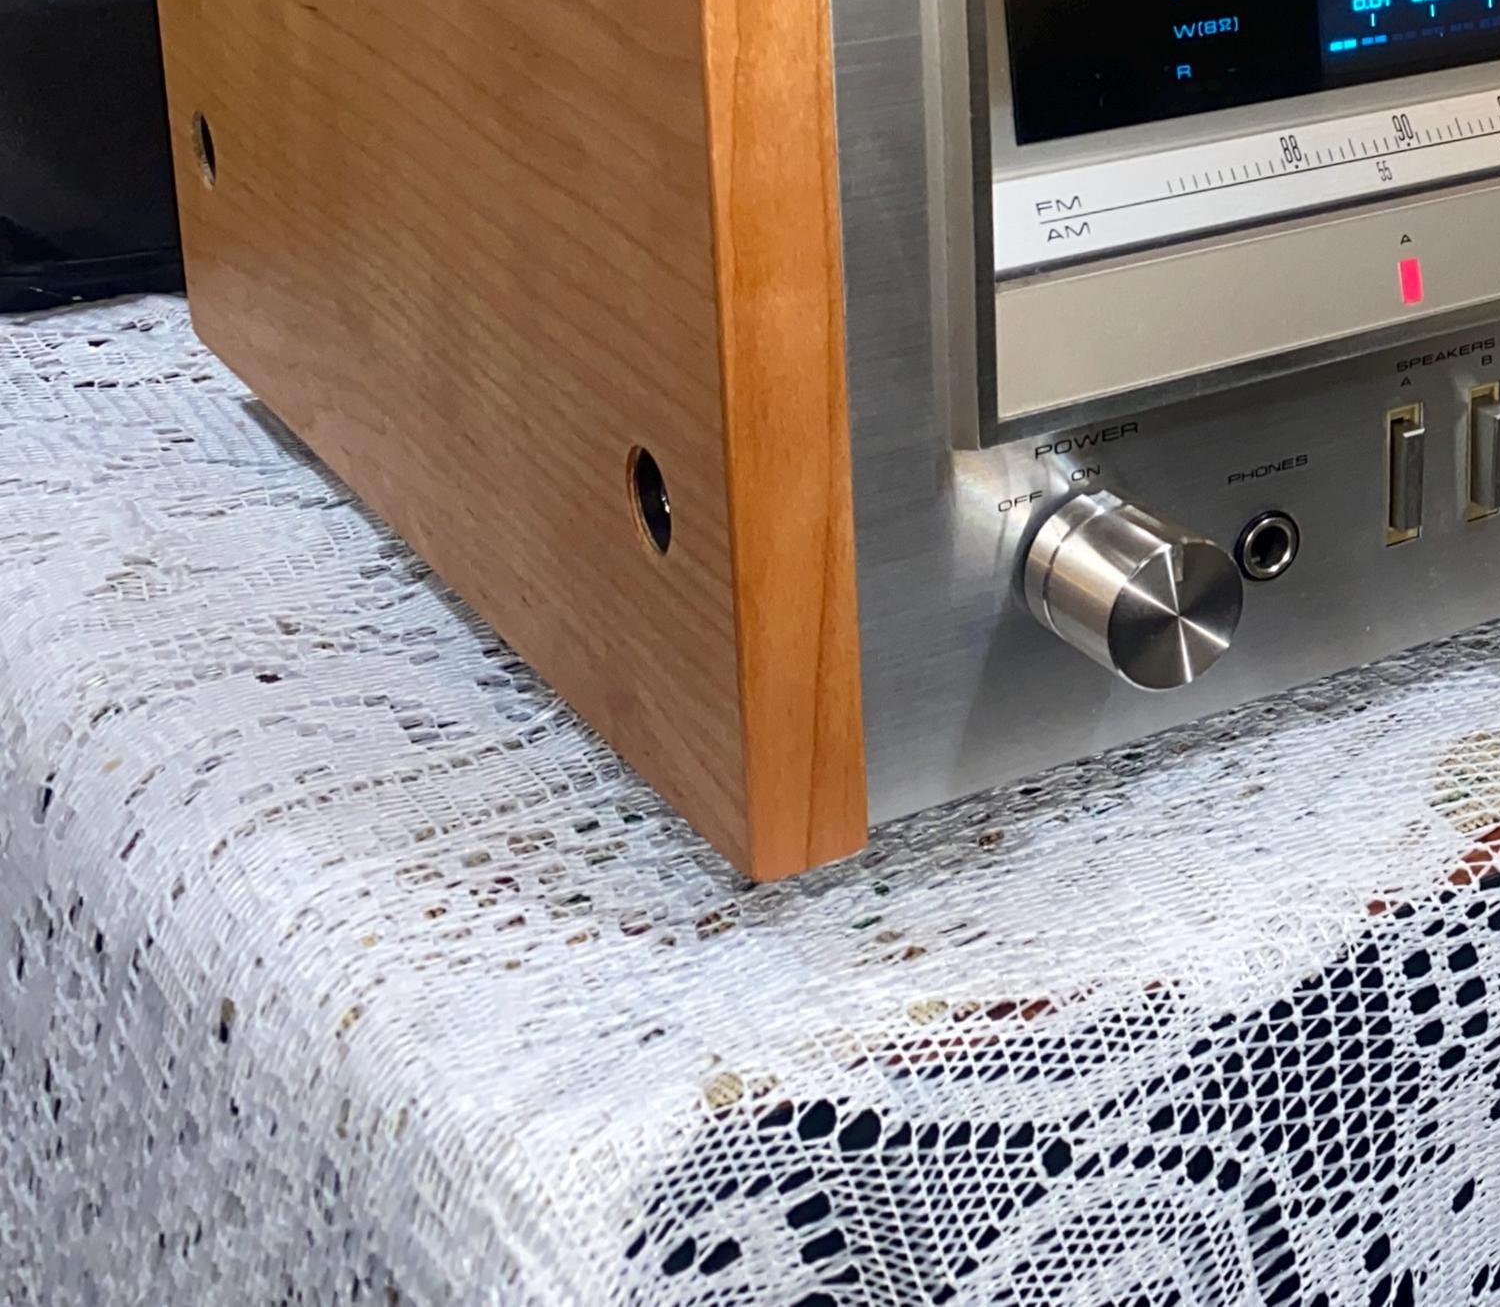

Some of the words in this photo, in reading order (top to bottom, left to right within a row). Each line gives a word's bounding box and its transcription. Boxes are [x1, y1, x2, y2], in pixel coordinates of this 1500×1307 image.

[1176, 64, 1191, 80] R
[1280, 135, 1302, 163] 88
[1393, 114, 1414, 142] 90
[1375, 160, 1393, 182] 55
[1036, 195, 1083, 217] FM
[1046, 221, 1091, 243] AM
[1400, 234, 1411, 244] A
[1397, 337, 1496, 373] SPEAKERS
[1481, 354, 1493, 366] B
[1401, 377, 1411, 387] A
[1035, 422, 1139, 460] POWER
[1072, 465, 1102, 482] ON
[1228, 454, 1308, 485] PHONES
[998, 490, 1043, 513] OFF
